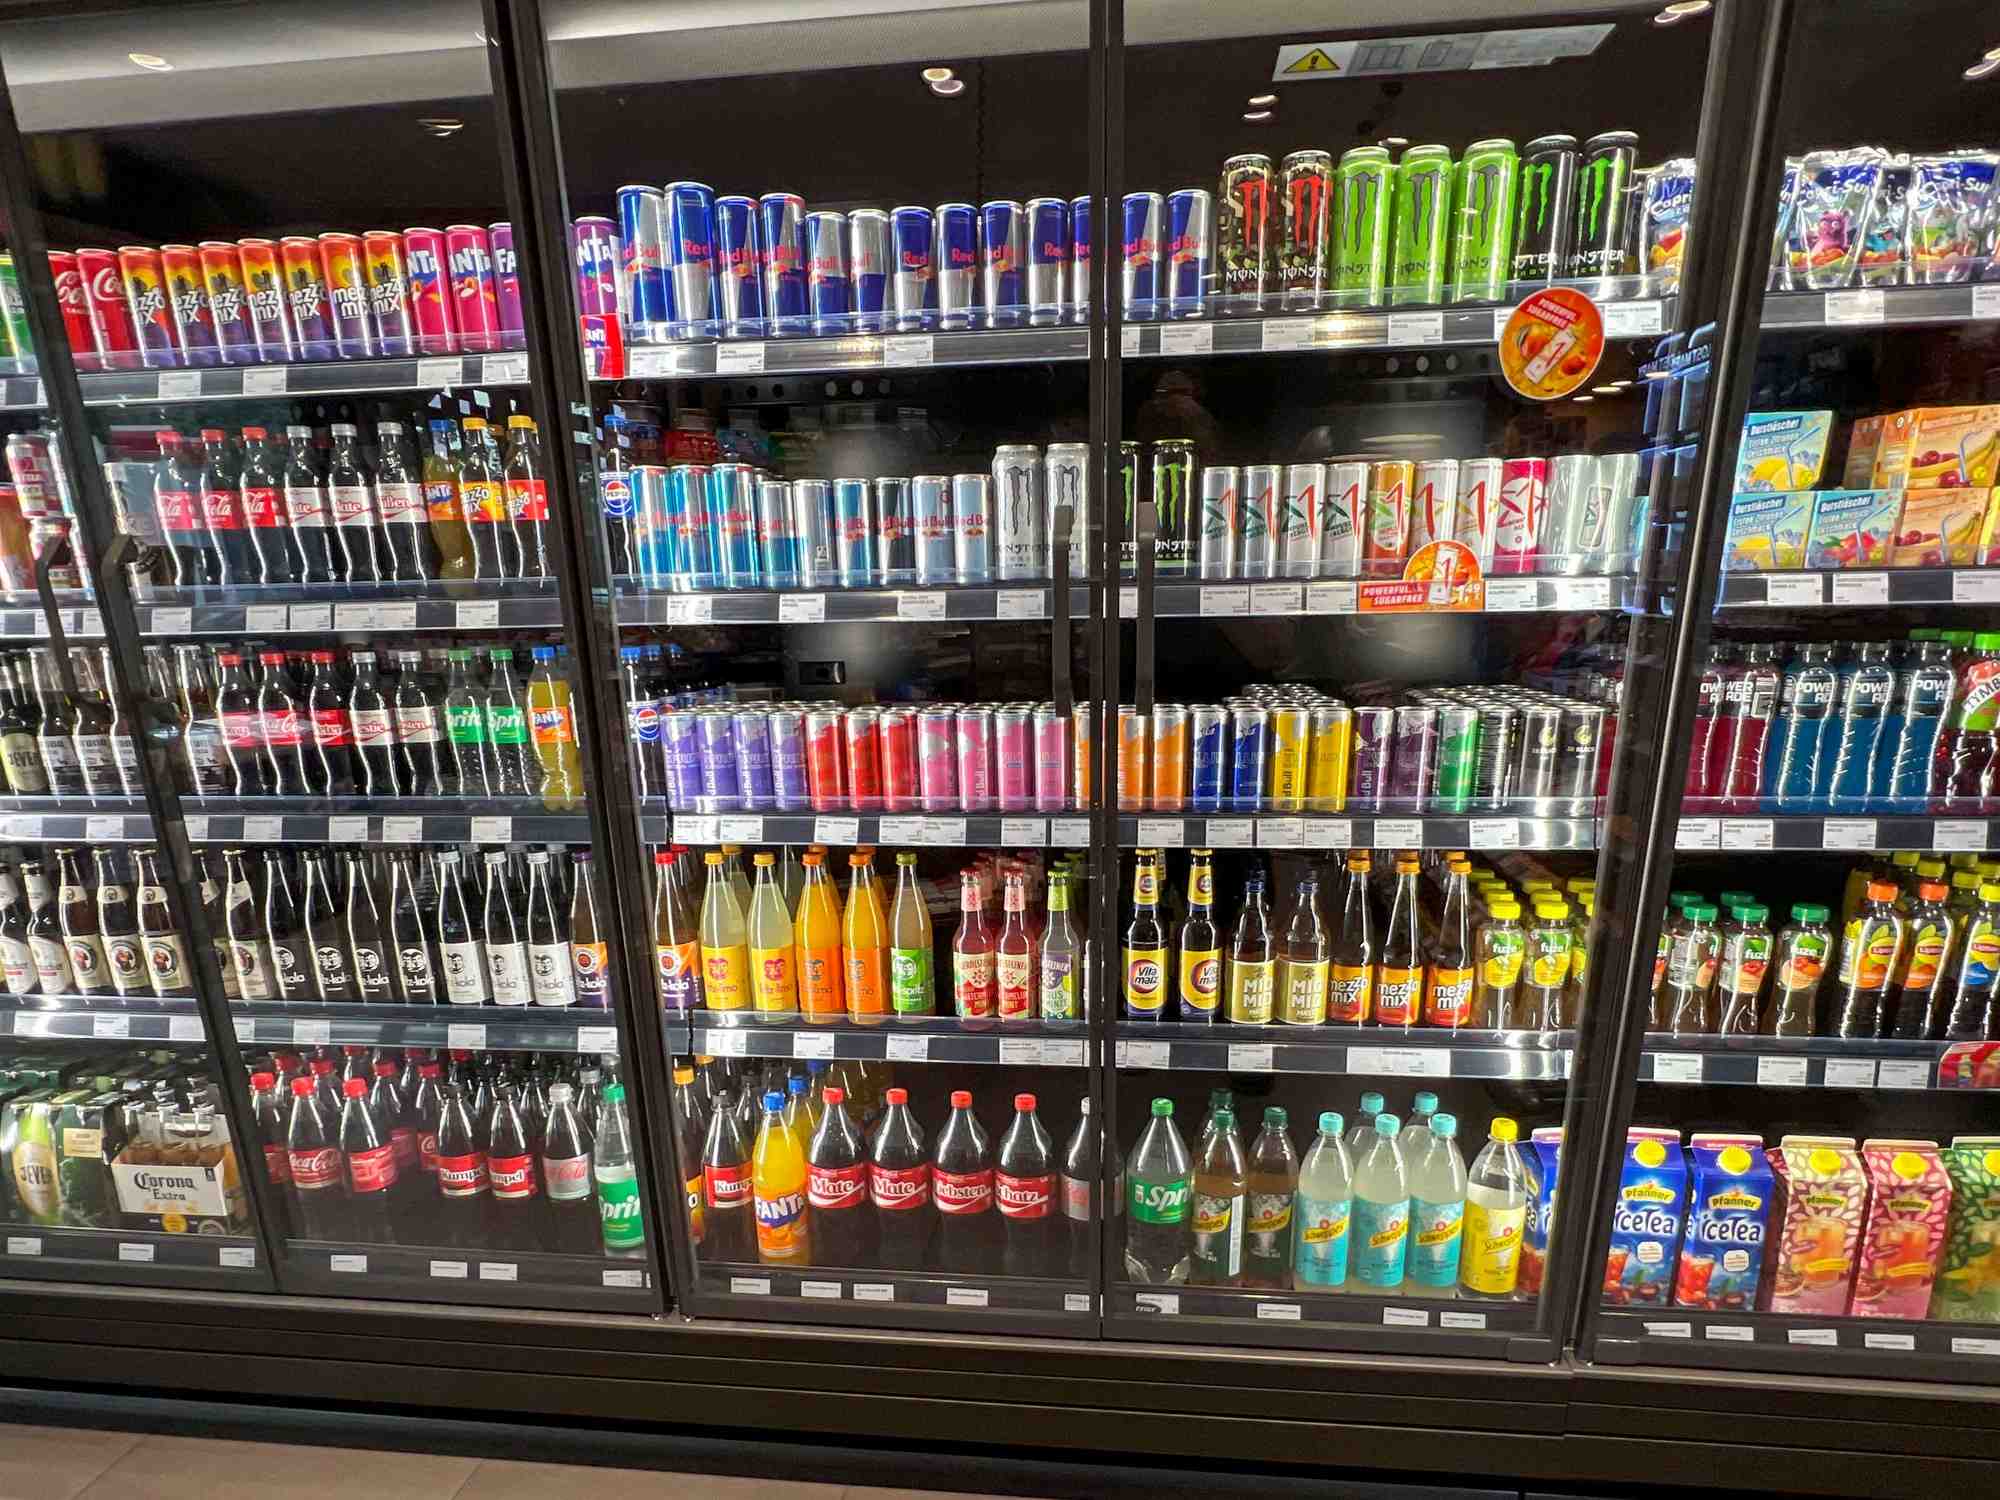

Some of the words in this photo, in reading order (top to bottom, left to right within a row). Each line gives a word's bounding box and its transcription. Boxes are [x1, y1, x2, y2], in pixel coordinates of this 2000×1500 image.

[1331, 989, 1357, 1003] mix
[134, 1172, 195, 1190] Corona
[811, 1175, 854, 1195] Mate
[873, 1175, 915, 1195] Mate
[153, 1190, 186, 1201] Extra
